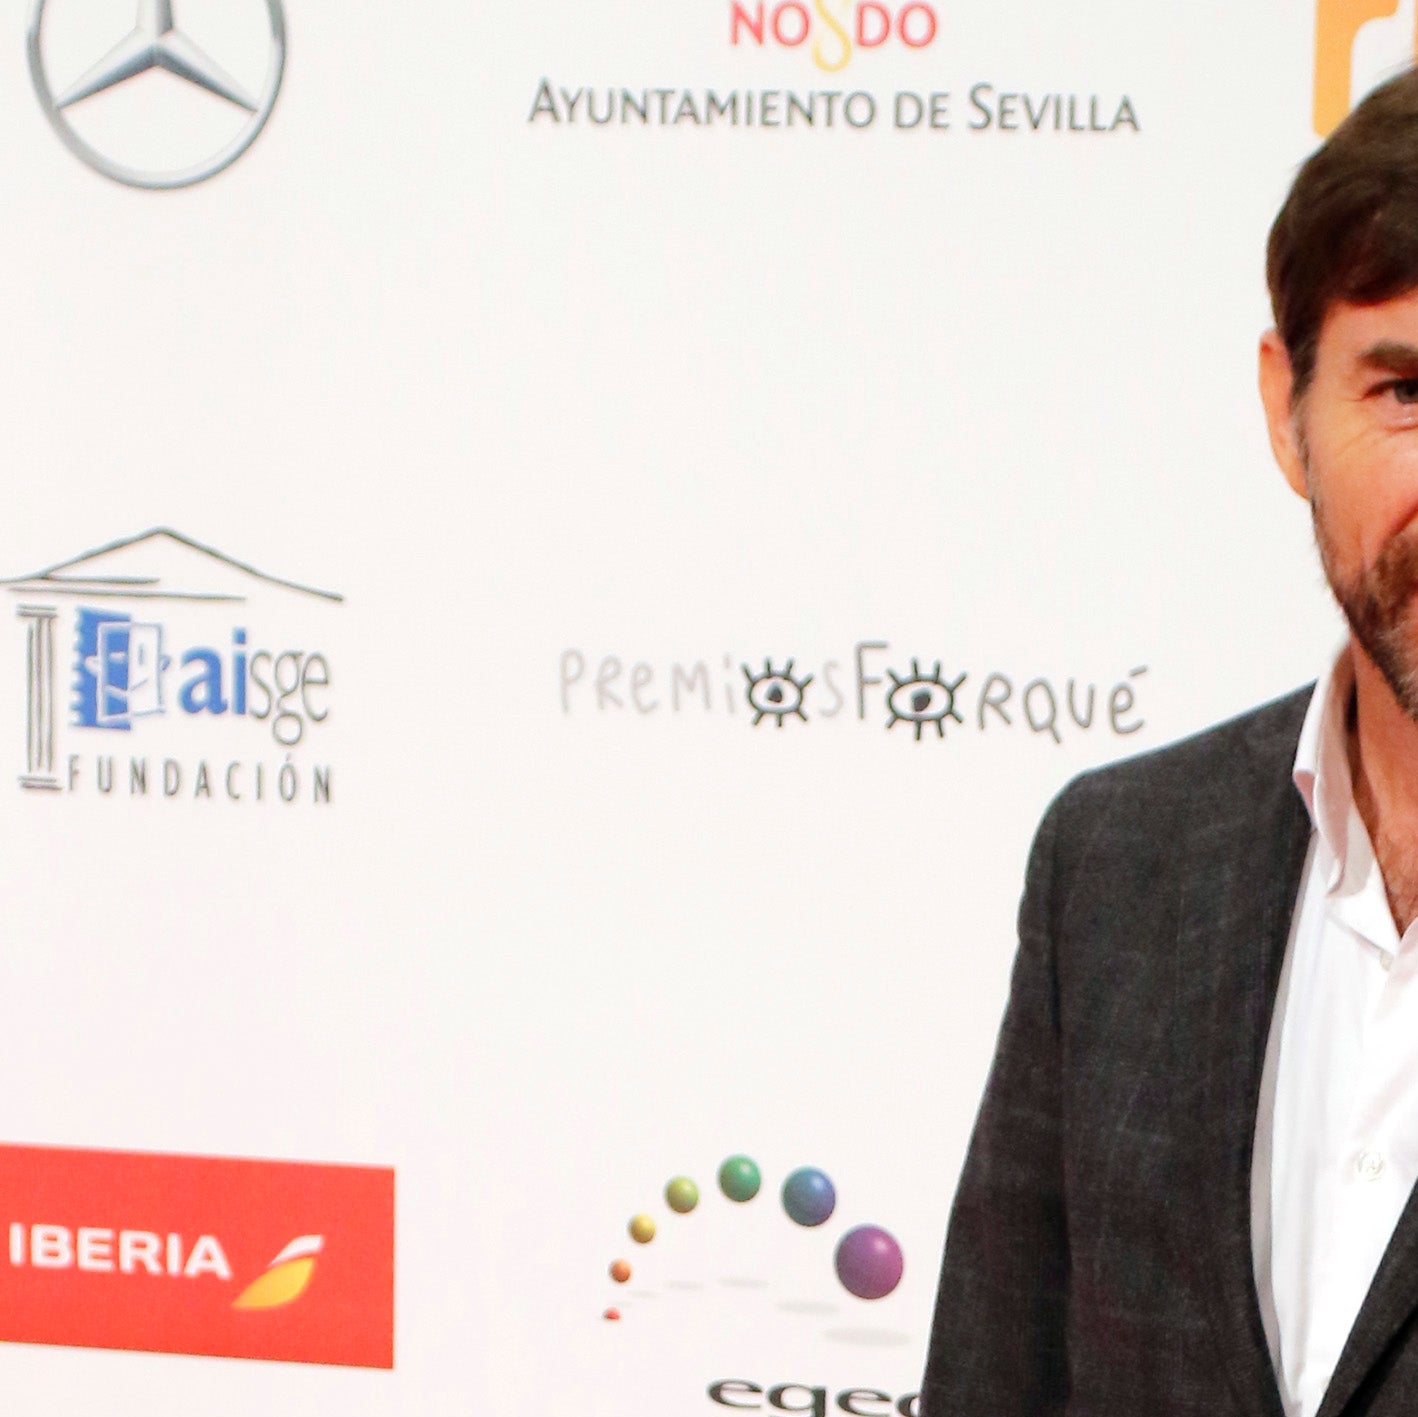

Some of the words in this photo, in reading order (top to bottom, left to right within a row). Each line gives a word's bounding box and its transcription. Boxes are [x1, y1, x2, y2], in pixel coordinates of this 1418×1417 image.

[528, 78, 877, 130] AYUNTAMIENTO
[894, 91, 951, 131] DE
[968, 82, 1141, 133] SEVILLA
[178, 626, 331, 746] aisge
[68, 753, 332, 803] FUNDACIÓN
[9, 1222, 233, 1281] IBERIA
